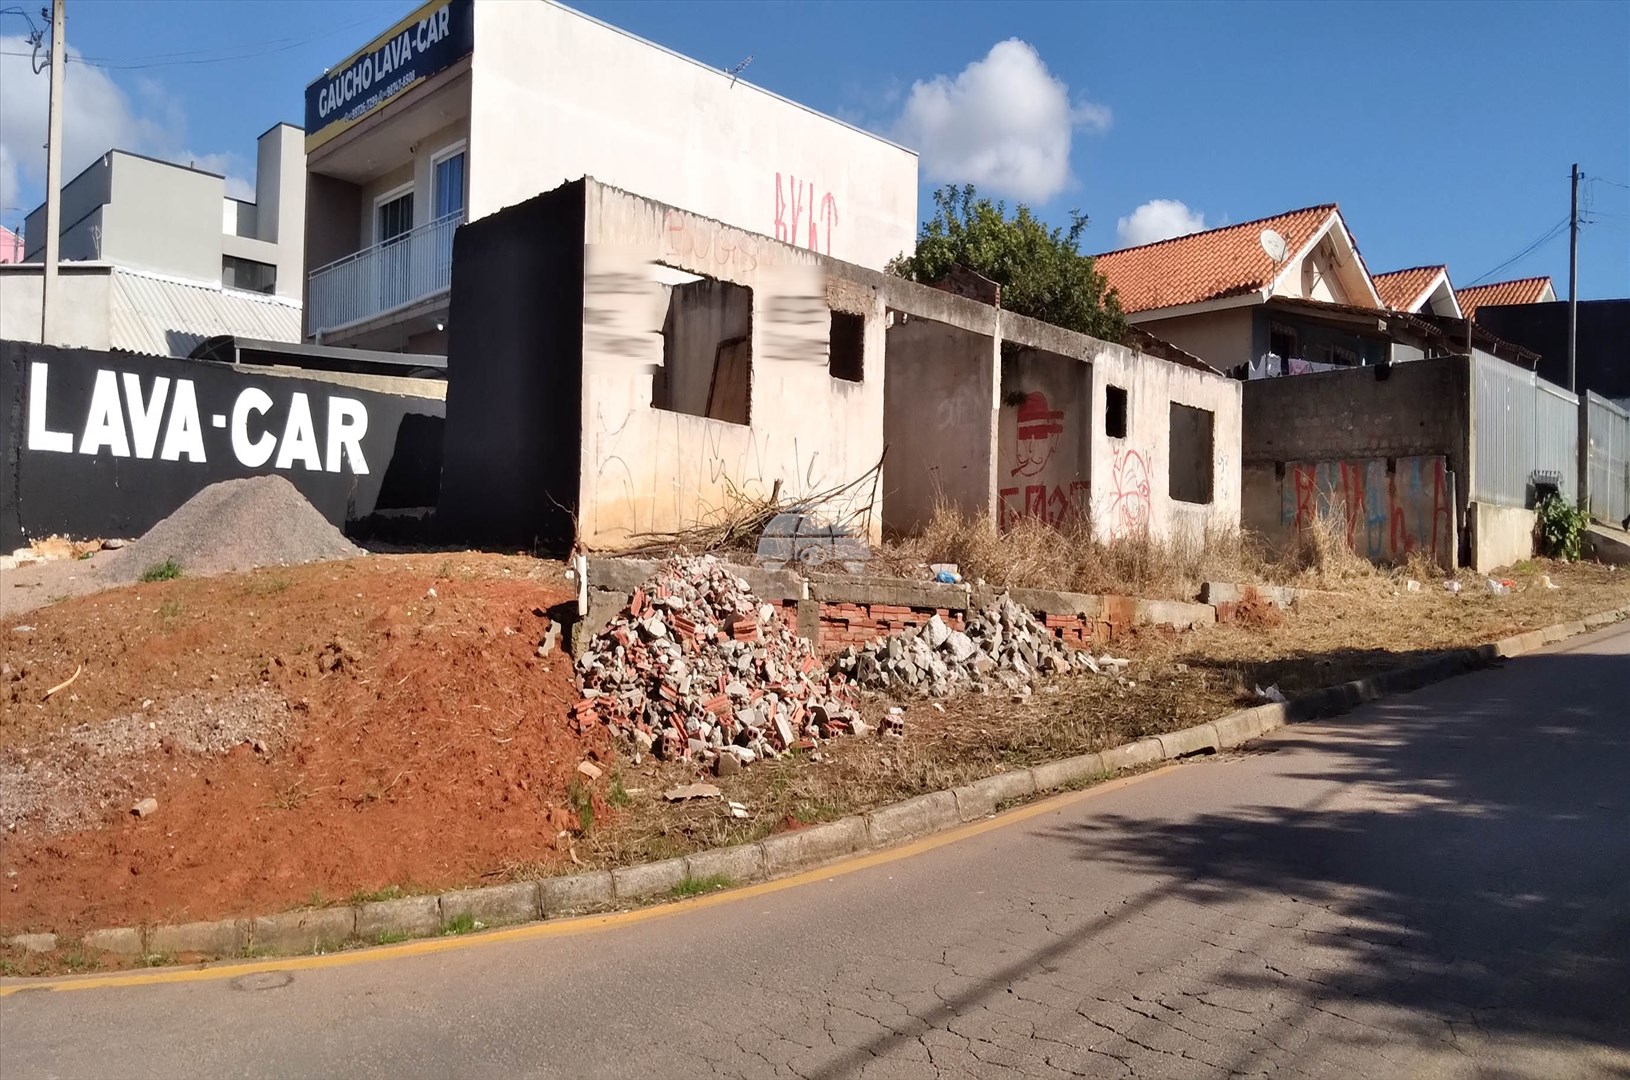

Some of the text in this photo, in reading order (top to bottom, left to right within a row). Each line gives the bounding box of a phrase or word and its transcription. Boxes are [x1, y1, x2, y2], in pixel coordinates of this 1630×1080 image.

[318, 4, 450, 119] GAÚCHO LAVA-CAR
[28, 362, 370, 475] LAVA-CAR
